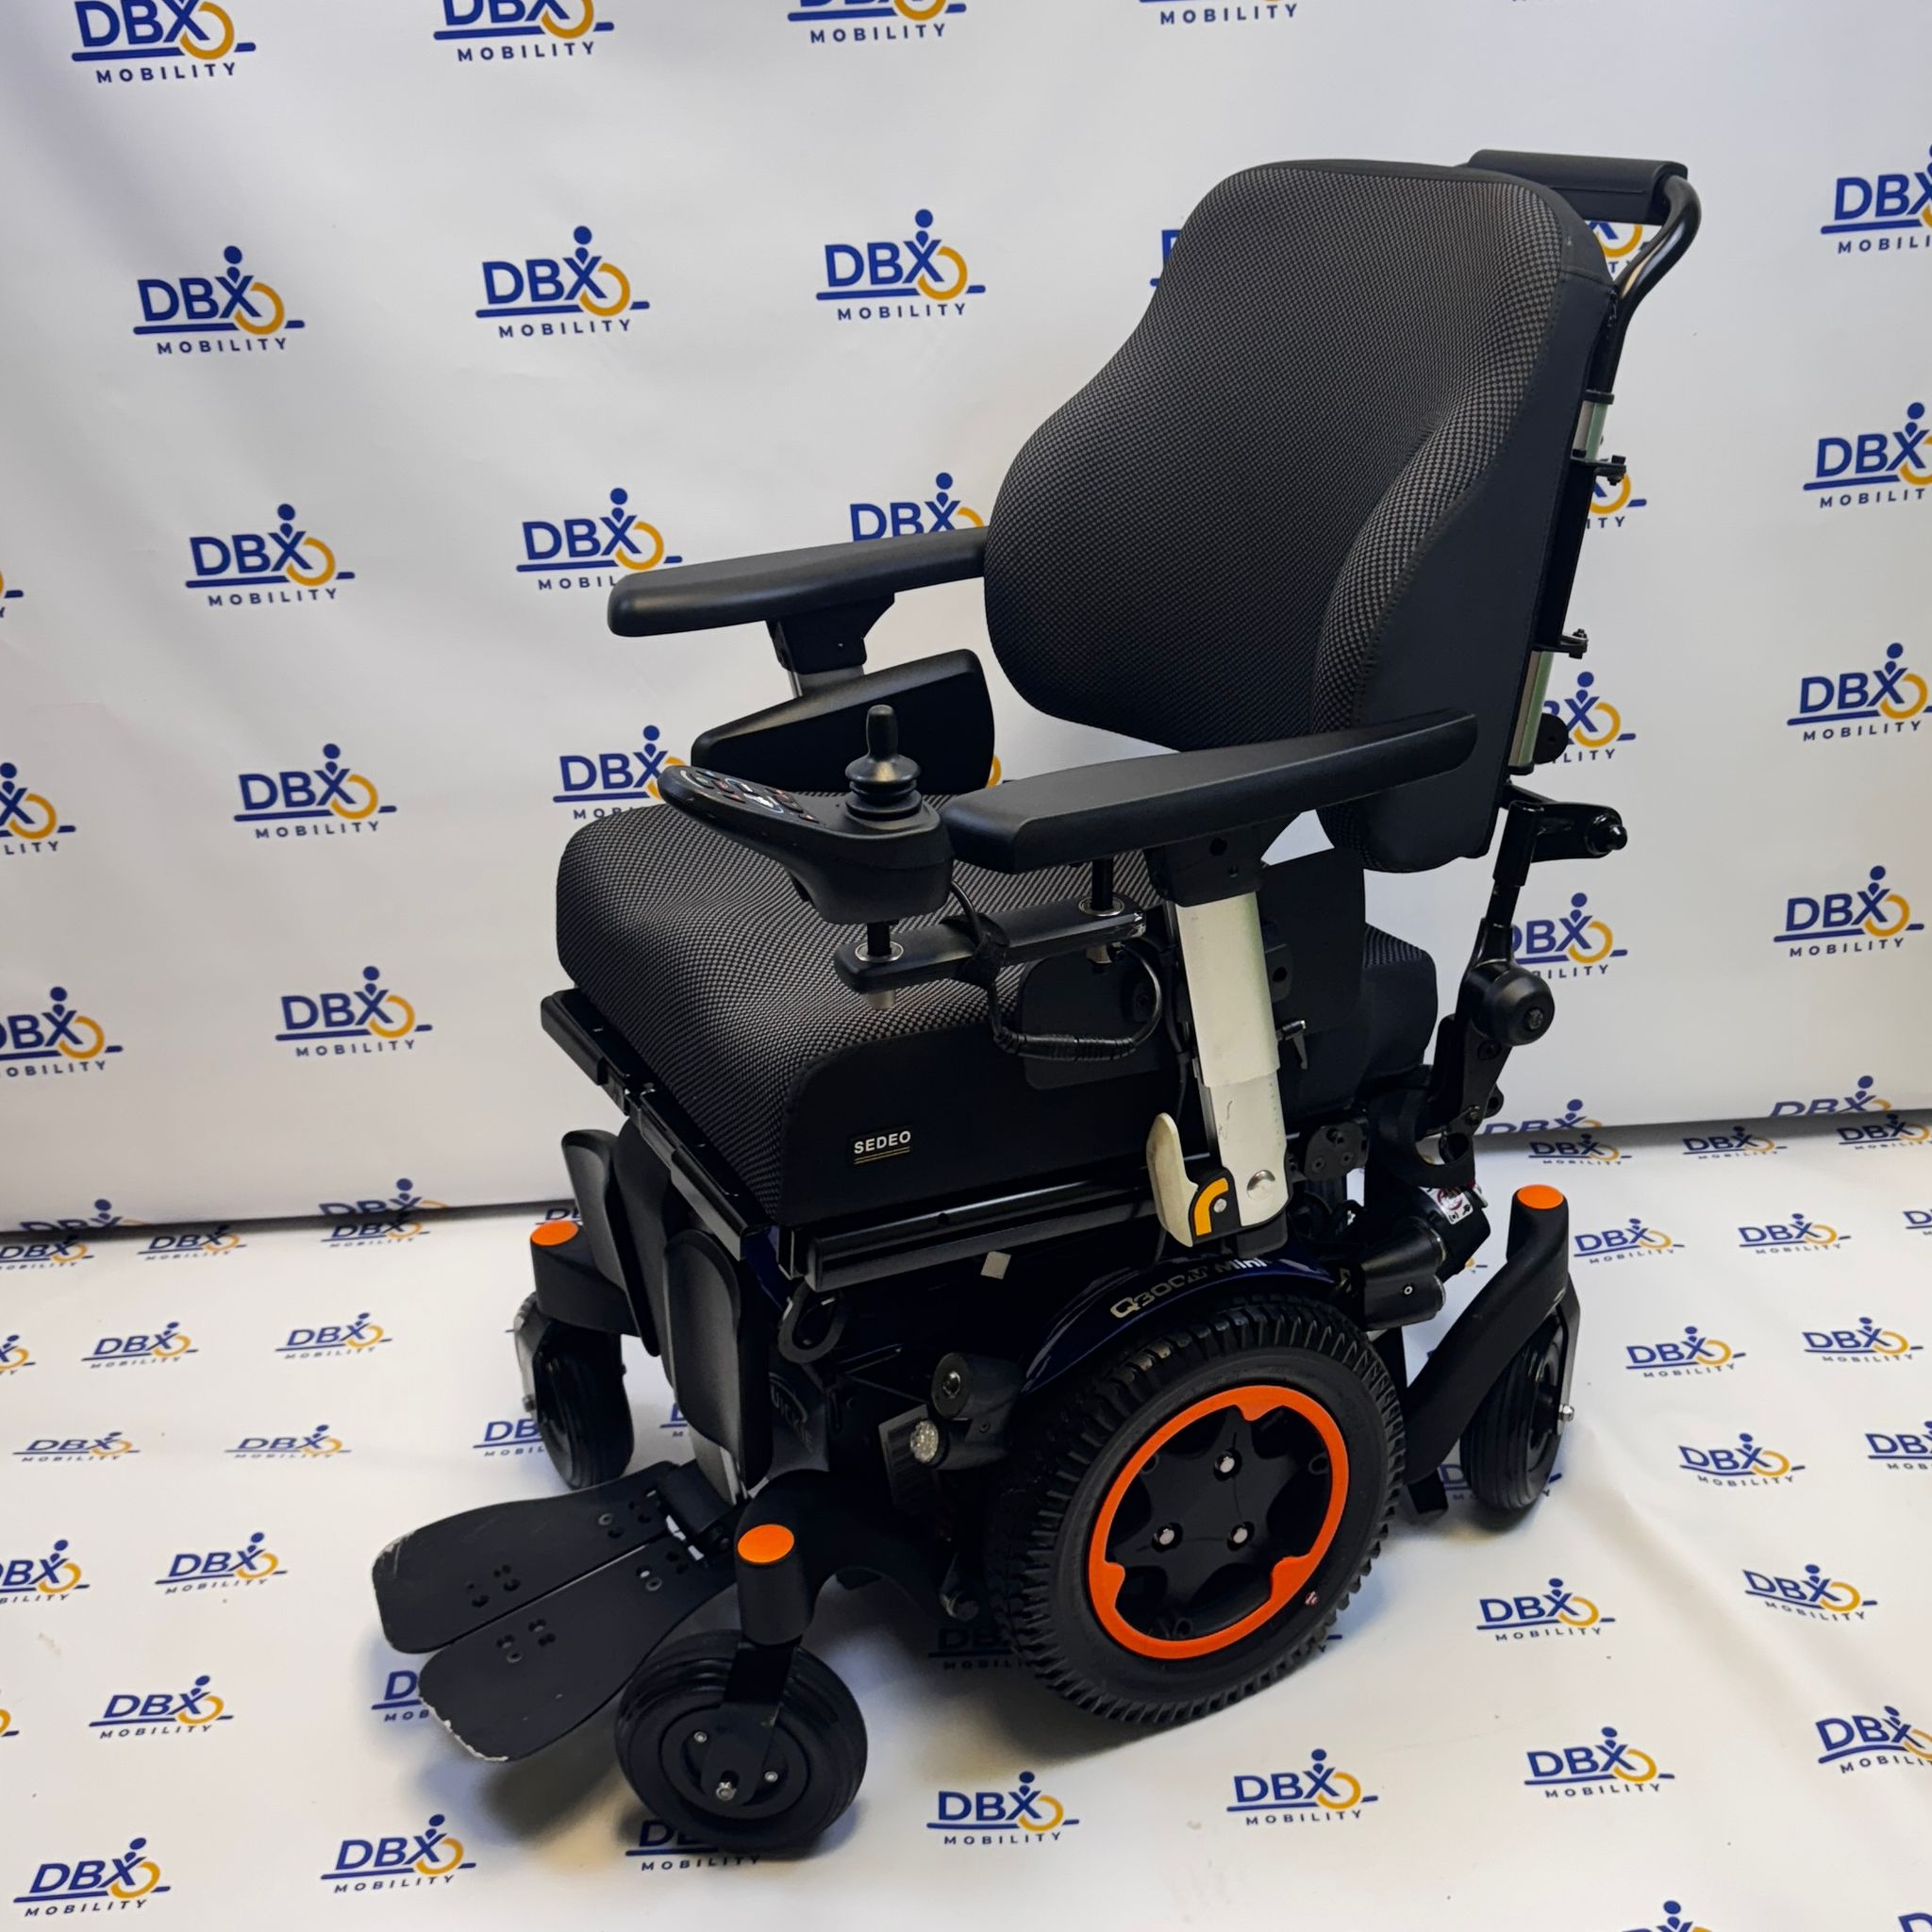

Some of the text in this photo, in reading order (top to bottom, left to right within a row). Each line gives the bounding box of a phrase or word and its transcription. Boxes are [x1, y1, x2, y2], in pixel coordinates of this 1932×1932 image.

[73, 0, 209, 46] DBX
[1160, 3, 1297, 25] MOBILITY
[810, 23, 945, 43] MOBILITY
[457, 41, 593, 61] MOBILITY
[96, 62, 236, 83] MOBILITY
[1838, 235, 1931, 254] MOBILI
[824, 240, 944, 287] DBX
[482, 256, 608, 304] DBX
[137, 275, 261, 321] DBX
[837, 303, 966, 320] MOBILITY
[498, 319, 630, 338] MOBILITY
[157, 337, 286, 355] MOBILITY
[1816, 428, 1931, 478] DBX
[1819, 488, 1925, 508] MOBILIT
[849, 500, 961, 541] DBX
[523, 514, 641, 560] DBX
[190, 530, 313, 576] DBX
[538, 575, 617, 590] MOBIL
[208, 588, 337, 607] MOBILITY
[1798, 667, 1908, 715] DBX
[1803, 721, 1921, 741] MOBILITY
[558, 751, 668, 791] DBX
[239, 768, 357, 810] DBX
[255, 822, 379, 839] MOBILITY
[1786, 889, 1890, 931] DBX
[1790, 938, 1904, 958] MOBILITY
[281, 990, 393, 1030] DBX
[0, 1010, 83, 1051] BX
[296, 1040, 415, 1057] MOBILITY
[7, 1060, 107, 1077] OBILITY
[1837, 1122, 1913, 1141] DBX
[854, 1130, 911, 1155] SEDEO
[1528, 1138, 1600, 1156] DBX
[1683, 1134, 1757, 1152] DBX
[1698, 1148, 1778, 1159] MOBILITY
[334, 1223, 405, 1238] DBX
[1574, 1227, 1655, 1253] DBX
[1739, 1224, 1822, 1242] DBX
[148, 1235, 222, 1250] DBX
[1756, 1242, 1840, 1255] MOBILITY
[144, 1250, 231, 1260] MOBILITY
[1589, 1248, 1674, 1264] MOBILITY
[93, 1333, 178, 1356] DBX
[286, 1324, 370, 1346] DBX
[1802, 1327, 1890, 1349] DBX
[285, 1346, 375, 1359] MOBILITY
[1626, 1338, 1714, 1364] DBX
[1822, 1354, 1914, 1364] MOBILITY
[90, 1357, 180, 1369] MOBILITY
[1643, 1362, 1735, 1378] MOBILITY
[484, 1419, 540, 1441] DB
[26, 1439, 117, 1451] DBX
[238, 1436, 329, 1450] DBX
[484, 1446, 544, 1457] MOBIL
[1865, 1433, 1932, 1455] DB
[1678, 1445, 1772, 1471] DBX
[1698, 1474, 1793, 1487] MOBILITY
[0, 1557, 68, 1584] BX
[168, 1549, 265, 1577] DBX
[165, 1578, 267, 1594] MOBILITY
[1742, 1569, 1841, 1603] DBX
[1479, 1592, 1579, 1622] DBX
[1764, 1601, 1865, 1622] MOBILITY
[1495, 1627, 1601, 1641] MOBILITY
[104, 1691, 210, 1718] DBX
[99, 1724, 212, 1739] MOBILITY
[1815, 1714, 1925, 1751] DBX
[1526, 1744, 1636, 1777] DBX
[1840, 1755, 1932, 1774] MOBILI
[1233, 1767, 1340, 1803] DBX
[1544, 1783, 1661, 1798] MOBILITY
[938, 1790, 1041, 1821] DBX
[1245, 1809, 1361, 1825] MOBILITY
[943, 1832, 1060, 1845] MOBILITY
[334, 1833, 447, 1870] DBX
[641, 1856, 760, 1872] MOBILITY
[29, 1857, 145, 1892] DBX
[333, 1874, 455, 1893] MOBILITY
[24, 1899, 147, 1917] MOBILITY
